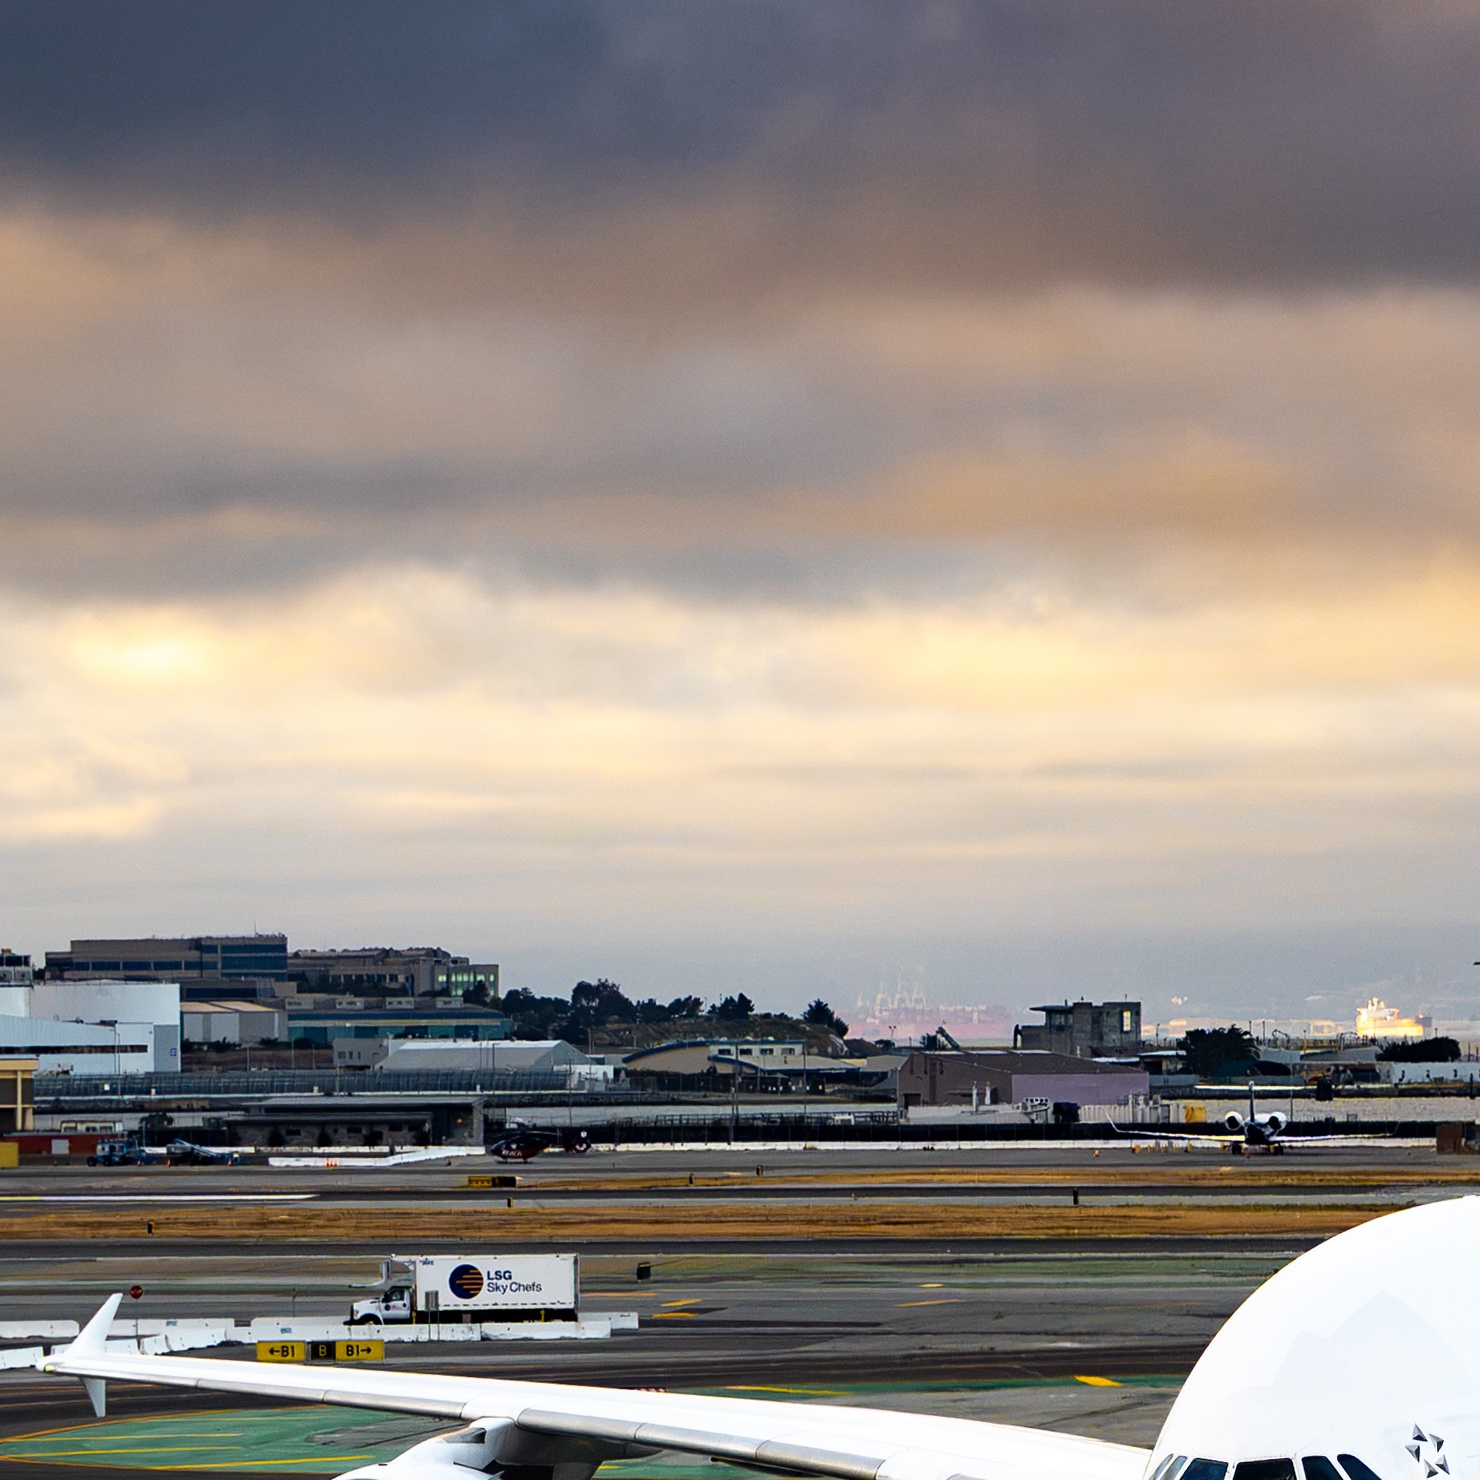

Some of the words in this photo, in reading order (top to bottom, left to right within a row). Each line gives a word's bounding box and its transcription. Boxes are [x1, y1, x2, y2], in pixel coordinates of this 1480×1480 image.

[487, 1270, 512, 1280] LSG
[487, 1281, 508, 1295] Sky
[509, 1281, 542, 1292] Chefs
[281, 1345, 295, 1357] B1
[319, 1345, 327, 1356] B
[346, 1345, 359, 1357] B1
